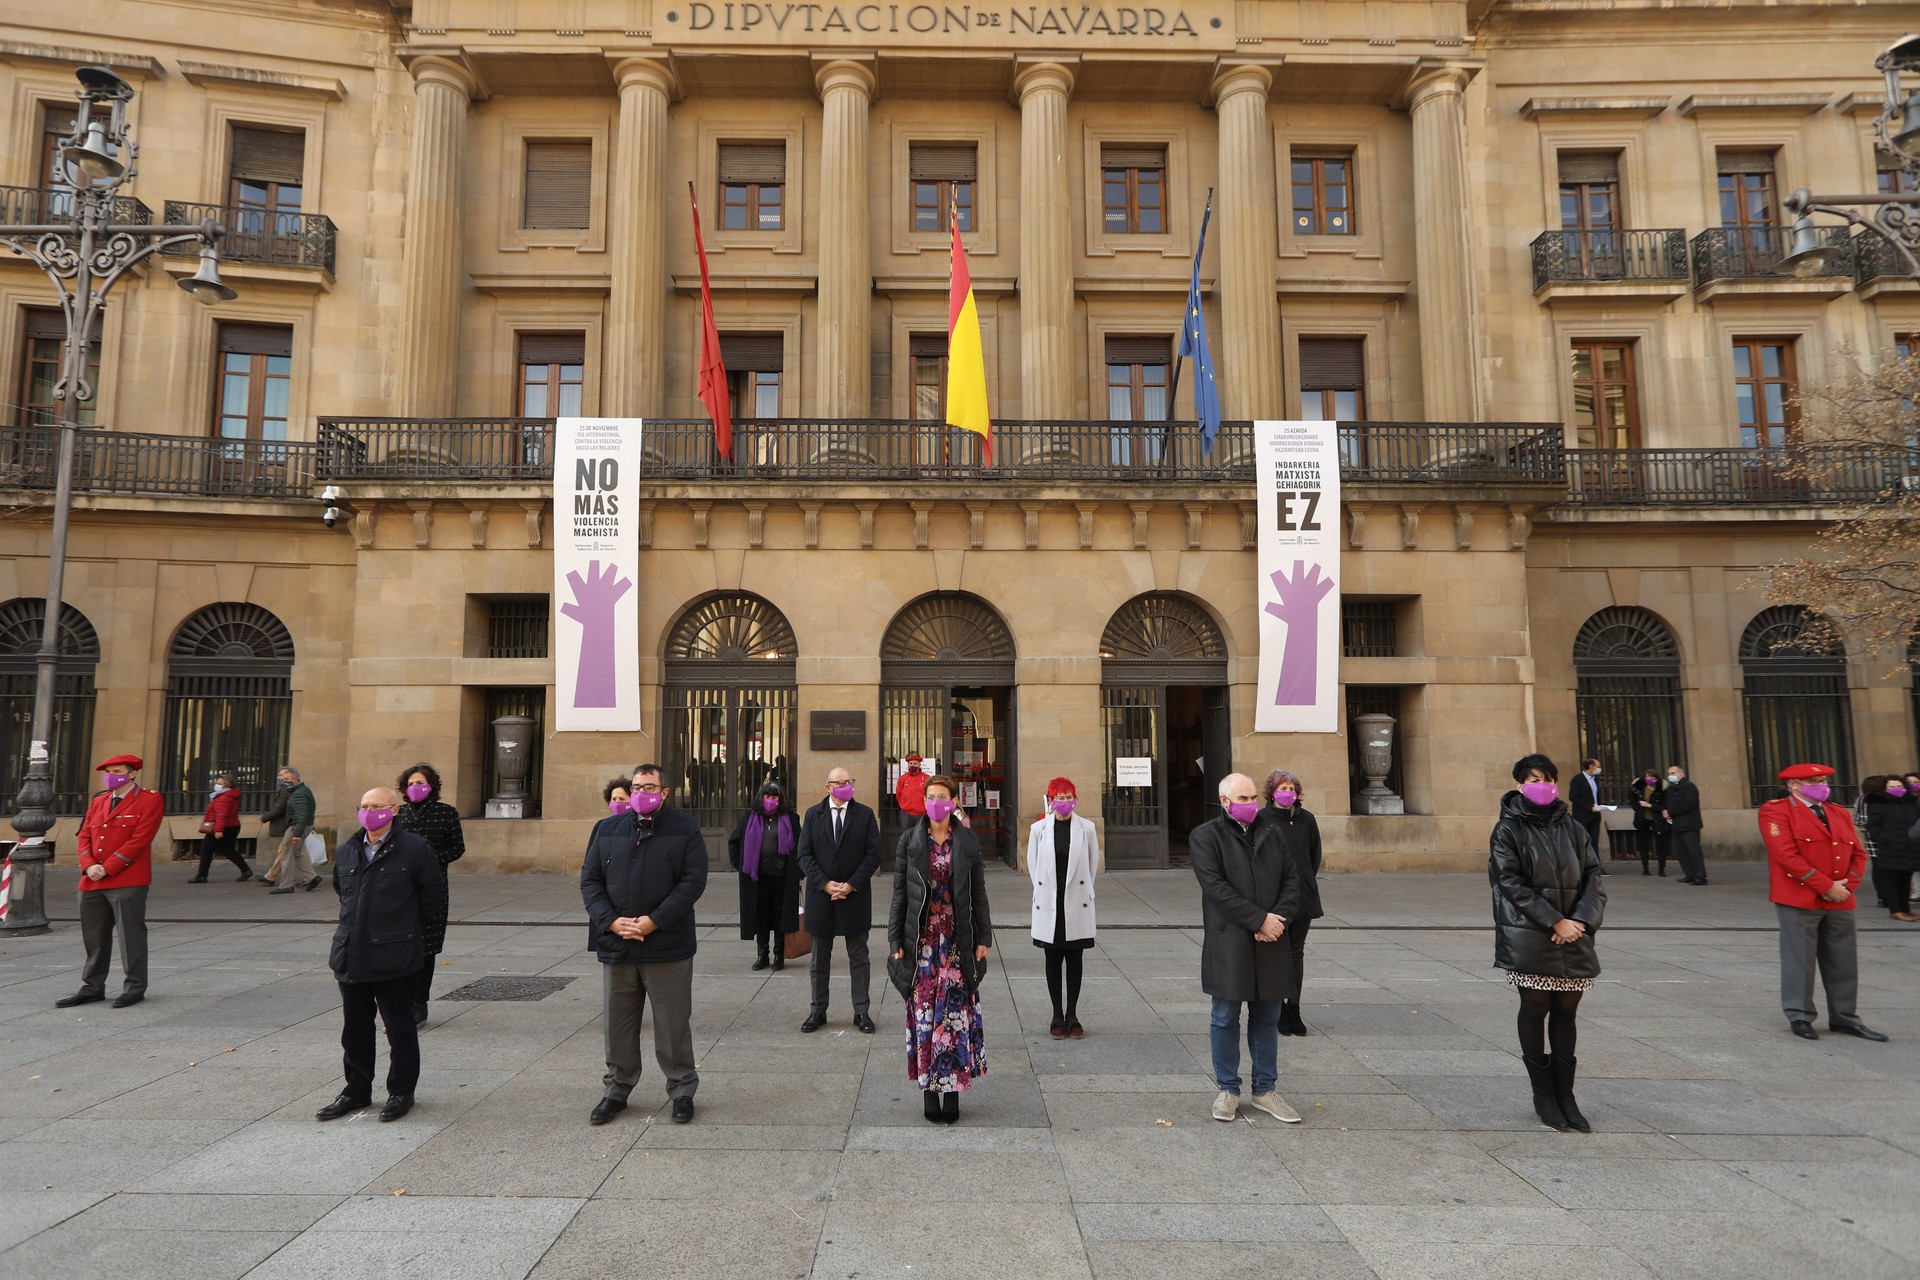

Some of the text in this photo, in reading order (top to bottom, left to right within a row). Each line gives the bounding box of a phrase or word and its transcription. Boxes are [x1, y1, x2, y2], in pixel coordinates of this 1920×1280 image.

[976, 12, 1001, 27] DE
[1009, 6, 1198, 36] NAVARRA
[575, 458, 618, 492] NO
[1276, 470, 1320, 479] MATXISTA
[1276, 480, 1321, 489] GEHIAGORIK
[574, 490, 618, 515] MÁS
[1277, 492, 1321, 531] EZ
[574, 518, 618, 526] VIOLENCIA
[574, 528, 618, 537] MACHISTA
